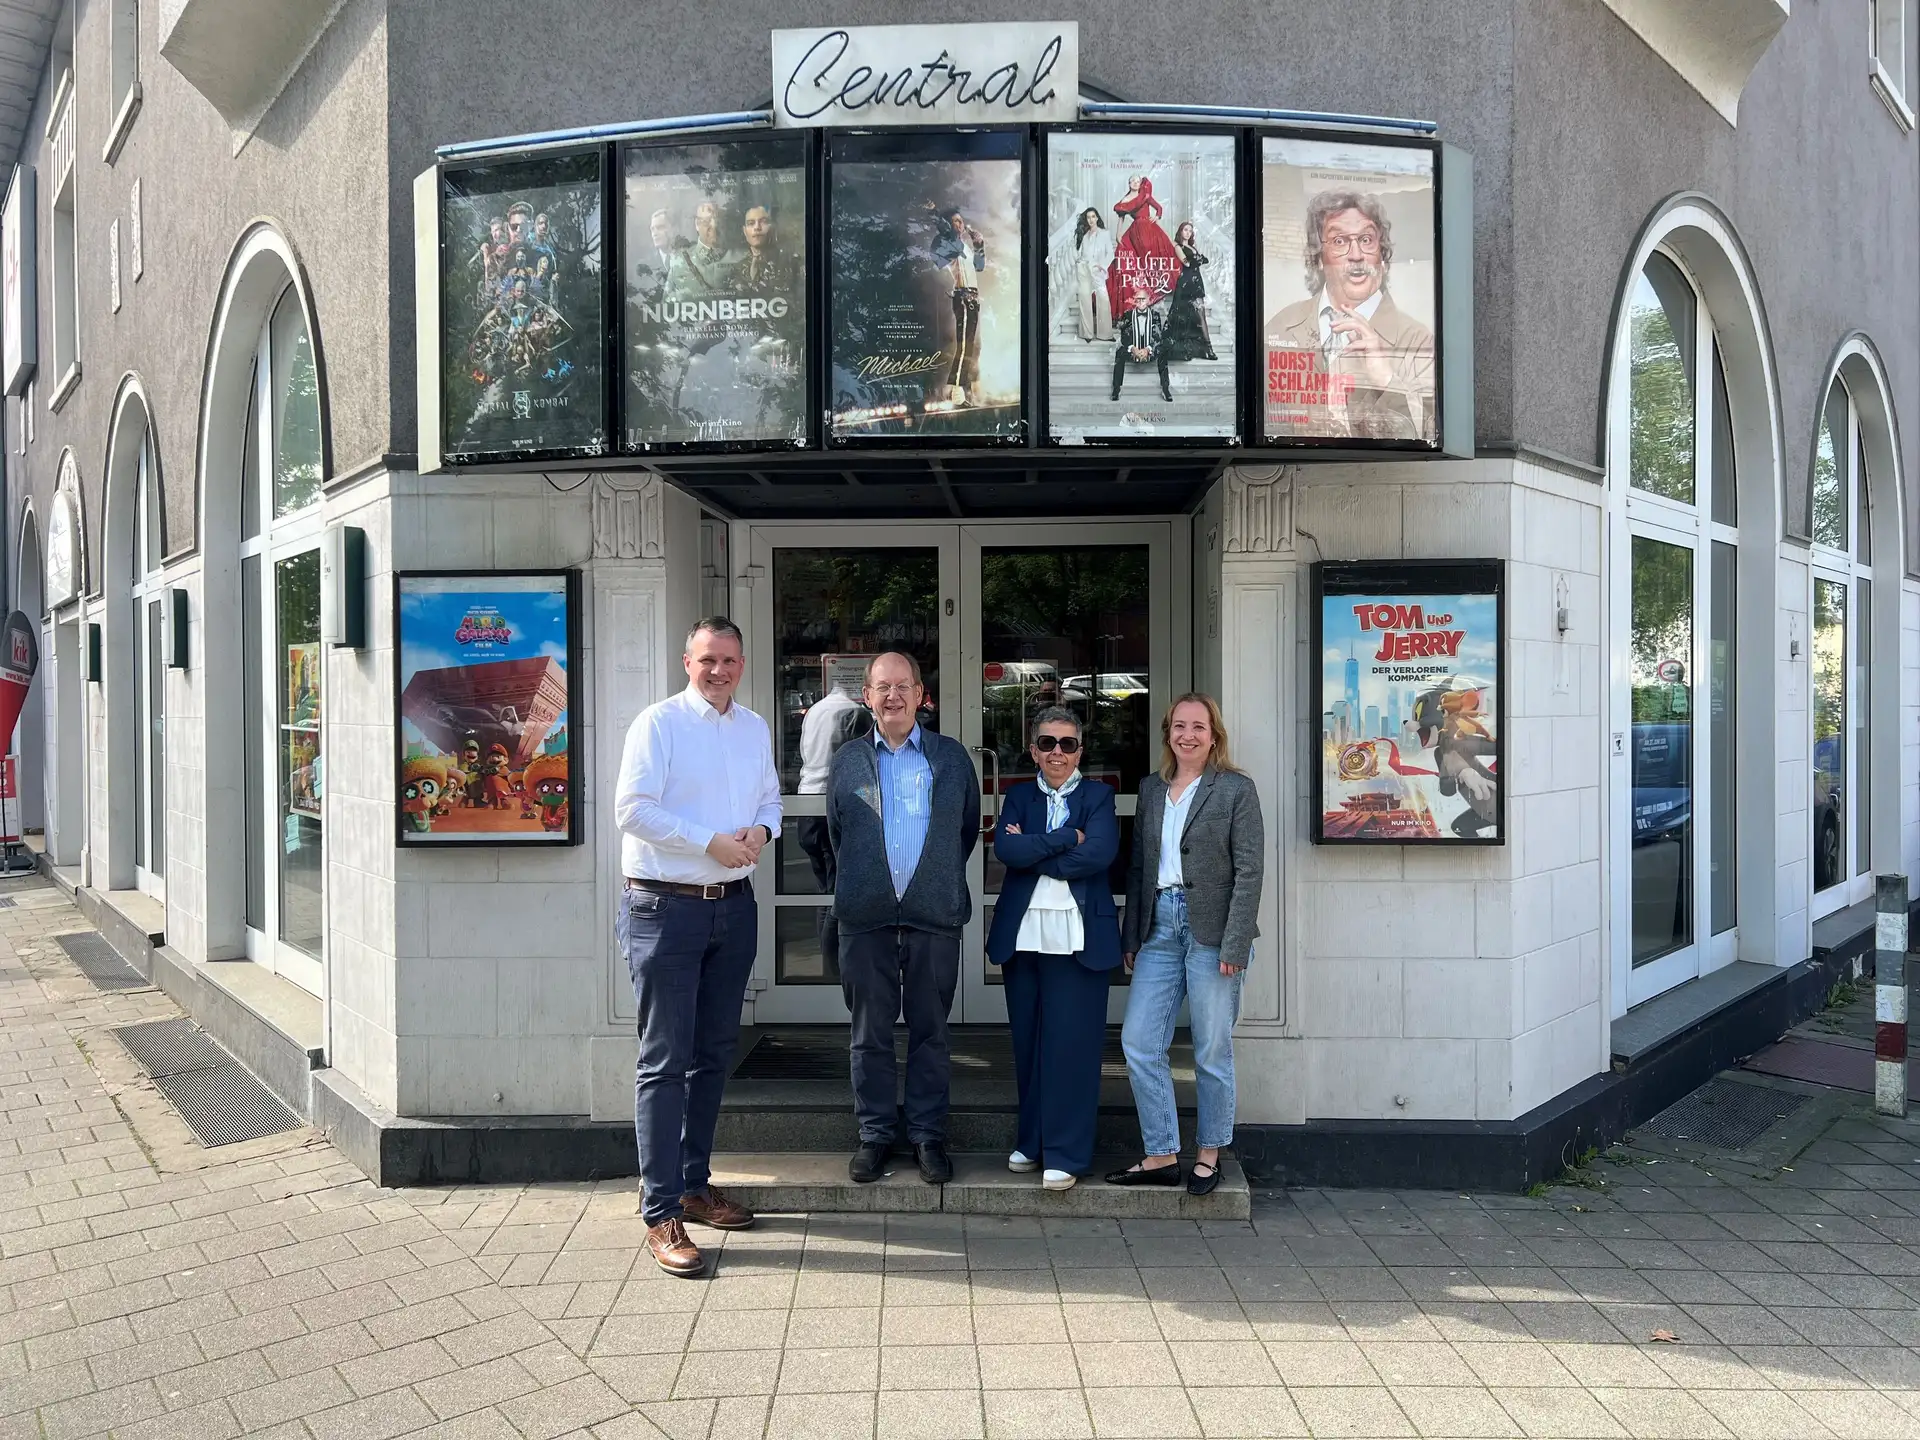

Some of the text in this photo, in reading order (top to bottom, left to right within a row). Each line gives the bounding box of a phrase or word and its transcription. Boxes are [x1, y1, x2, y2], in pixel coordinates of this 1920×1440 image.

[784, 30, 1062, 118] Central
[1115, 250, 1181, 271] TEUFEL
[642, 297, 788, 323] NÜRNBERG
[857, 350, 947, 380] Michael
[1268, 351, 1315, 371] HORST
[533, 396, 569, 409] KOMBAT
[1300, 392, 1317, 405] DAS
[722, 418, 742, 426] Kino
[1353, 603, 1454, 631] TOM UND
[454, 627, 512, 645] GALAXY
[1373, 629, 1467, 663] JERRY
[13, 636, 28, 664] kik
[1371, 666, 1449, 675] DER VERLORENE
